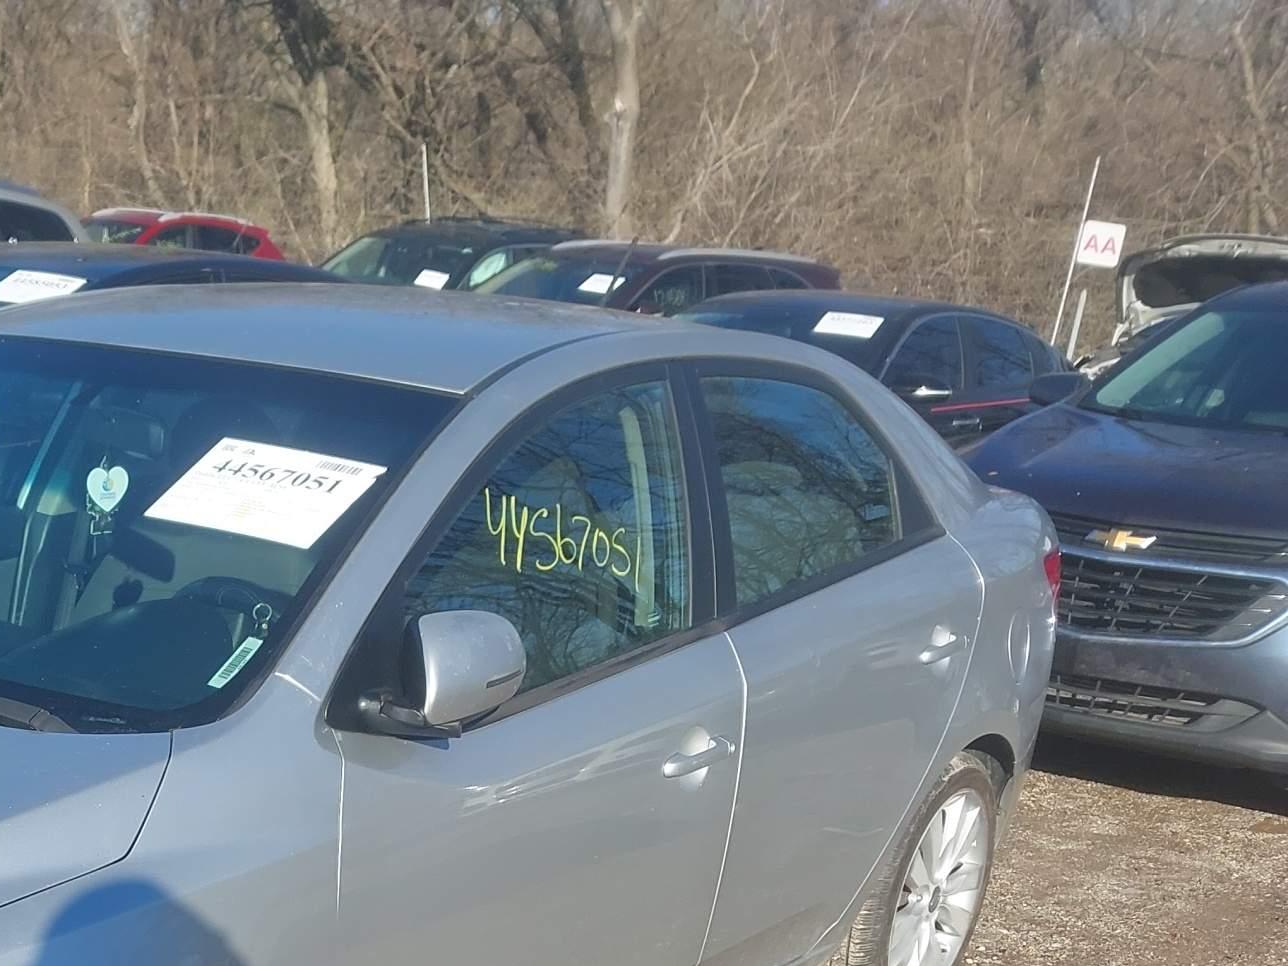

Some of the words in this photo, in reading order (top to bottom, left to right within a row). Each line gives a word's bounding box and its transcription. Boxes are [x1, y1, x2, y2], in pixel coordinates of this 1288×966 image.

[1084, 235, 1116, 255] AA
[212, 458, 343, 494] 44567051
[484, 486, 642, 593] 44567051
